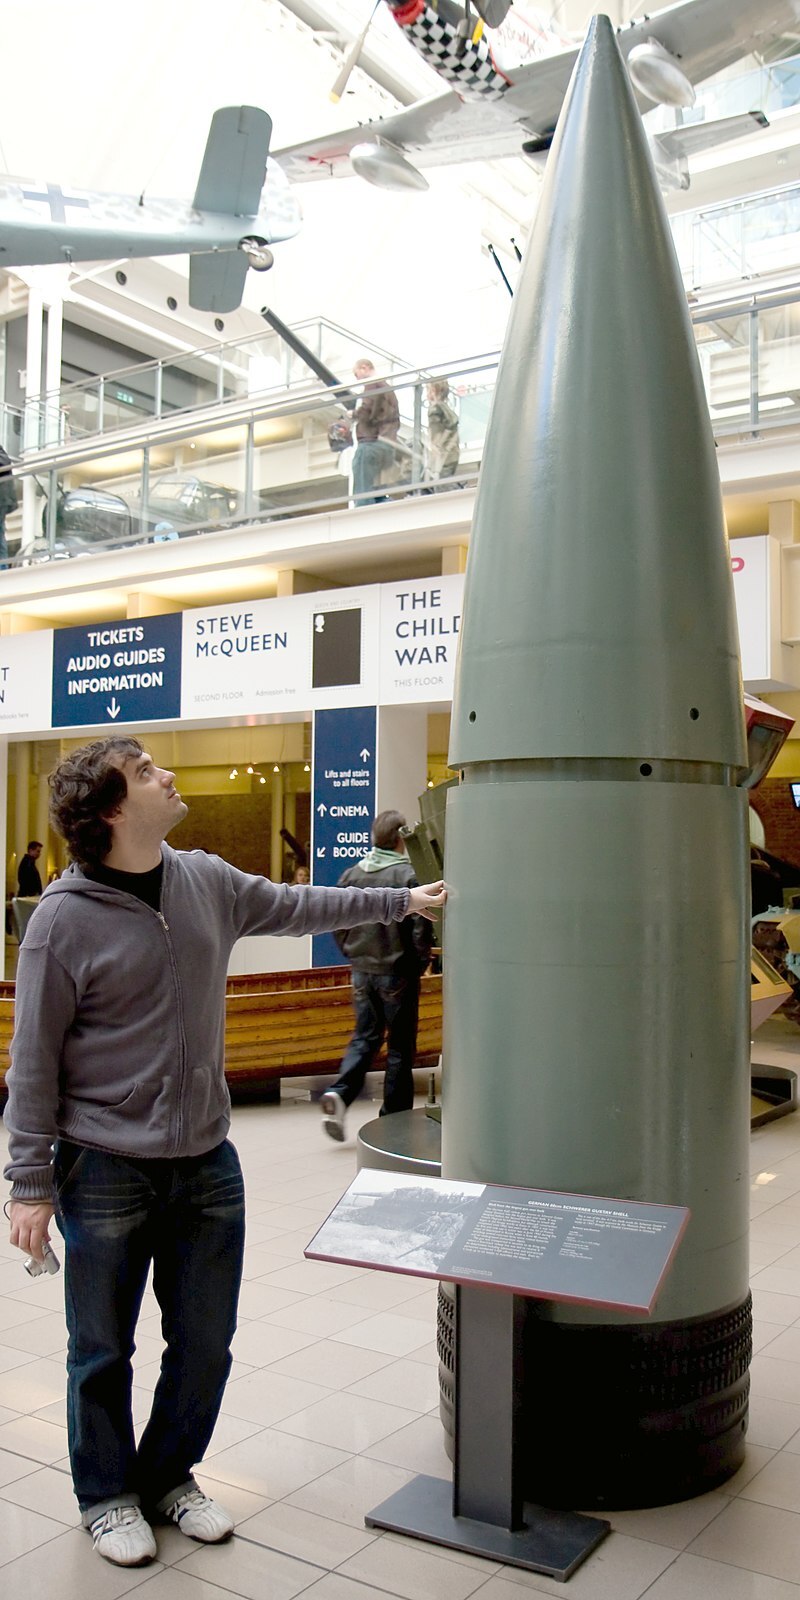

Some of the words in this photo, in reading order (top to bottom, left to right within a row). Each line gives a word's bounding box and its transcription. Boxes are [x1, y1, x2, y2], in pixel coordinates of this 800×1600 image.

[396, 589, 441, 611] THE
[196, 613, 253, 636] STEVE
[87, 626, 144, 647] TICKETS
[196, 632, 287, 658] McQUEEN
[66, 653, 111, 672] AUDIO
[113, 647, 166, 667] GUIDES
[395, 645, 448, 666] WAR
[67, 671, 163, 695] INFORMATION
[394, 677, 413, 688] THIS
[414, 676, 444, 686] FLOOR
[193, 692, 221, 702] SECOND
[222, 691, 243, 700] FLOOR
[325, 770, 338, 778] Lifts
[340, 770, 351, 778] and
[352, 769, 370, 777] stairs
[350, 778, 370, 787] floors
[329, 805, 369, 817] CINEMA
[336, 832, 369, 843] GUIDE
[333, 846, 369, 857] BOOKS
